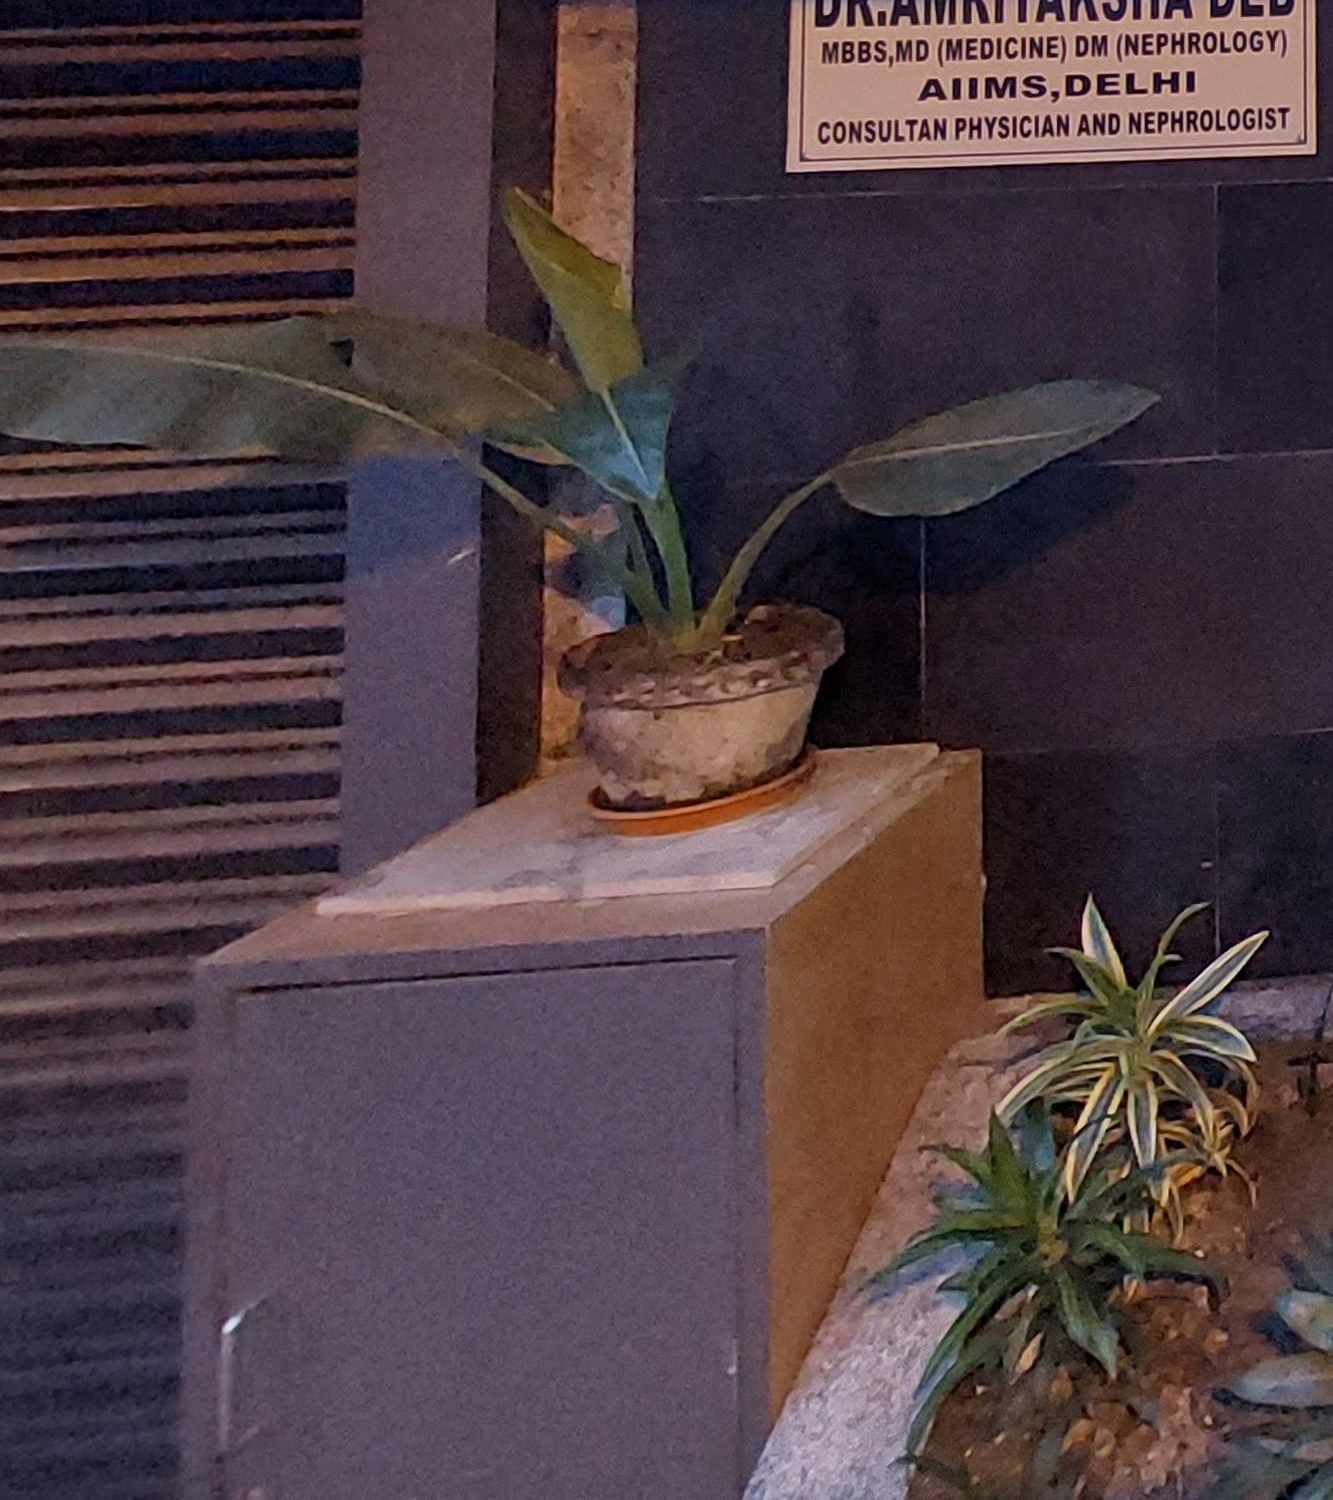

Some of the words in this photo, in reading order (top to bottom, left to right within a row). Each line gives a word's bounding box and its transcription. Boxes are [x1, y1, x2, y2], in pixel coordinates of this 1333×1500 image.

[821, 38, 930, 67] MBBS,MD
[937, 34, 1067, 67] (MEDICINE)
[1074, 34, 1109, 58] DM
[1116, 29, 1288, 63] (NEPHROLOGY)
[917, 70, 1197, 104] AIIMS,DELHI
[817, 117, 948, 145] CONSULTAN
[954, 114, 1071, 140] PHYSICIAN
[1076, 112, 1121, 138] AND
[1128, 107, 1291, 135] NEPHROLOGIST
